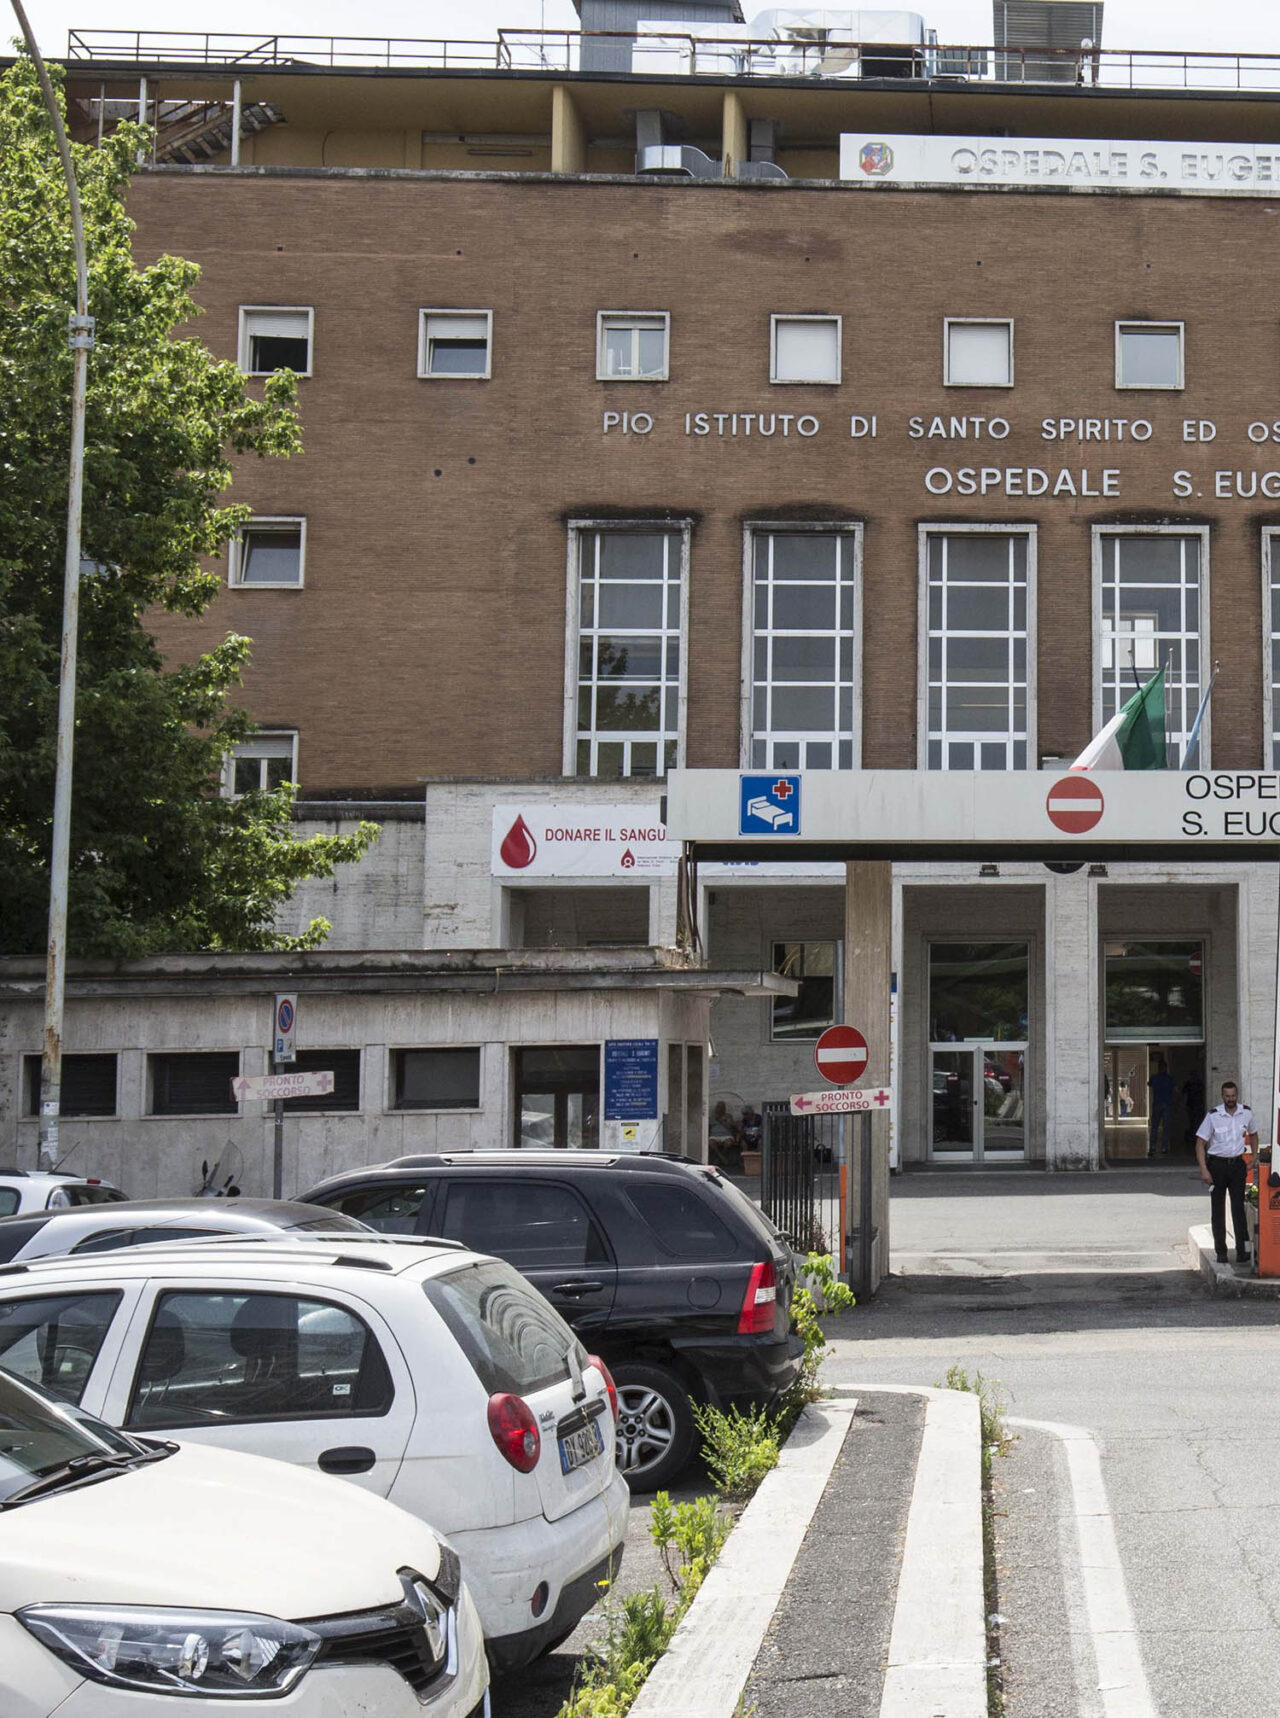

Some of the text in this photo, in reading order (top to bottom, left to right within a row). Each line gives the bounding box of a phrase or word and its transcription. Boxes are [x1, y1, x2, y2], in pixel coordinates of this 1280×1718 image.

[951, 148, 1128, 178] OSPEDALE
[1140, 152, 1168, 179] S.
[603, 411, 653, 435] PIO
[685, 413, 820, 436] ISTITUTO
[851, 415, 877, 438] DI
[908, 416, 1010, 439] SANTO
[1041, 418, 1153, 441] SPIRITO
[1182, 420, 1217, 442] ED
[924, 467, 1121, 497] OSPEDALE
[1172, 470, 1203, 498] S.
[1181, 810, 1208, 836] S.
[545, 828, 667, 841] DONARE IL SANGU
[263, 1075, 305, 1087] PRONTO
[257, 1086, 310, 1098] SOCCORSO
[821, 1091, 863, 1102] PRONTO
[815, 1101, 870, 1112] SOCCORSO
